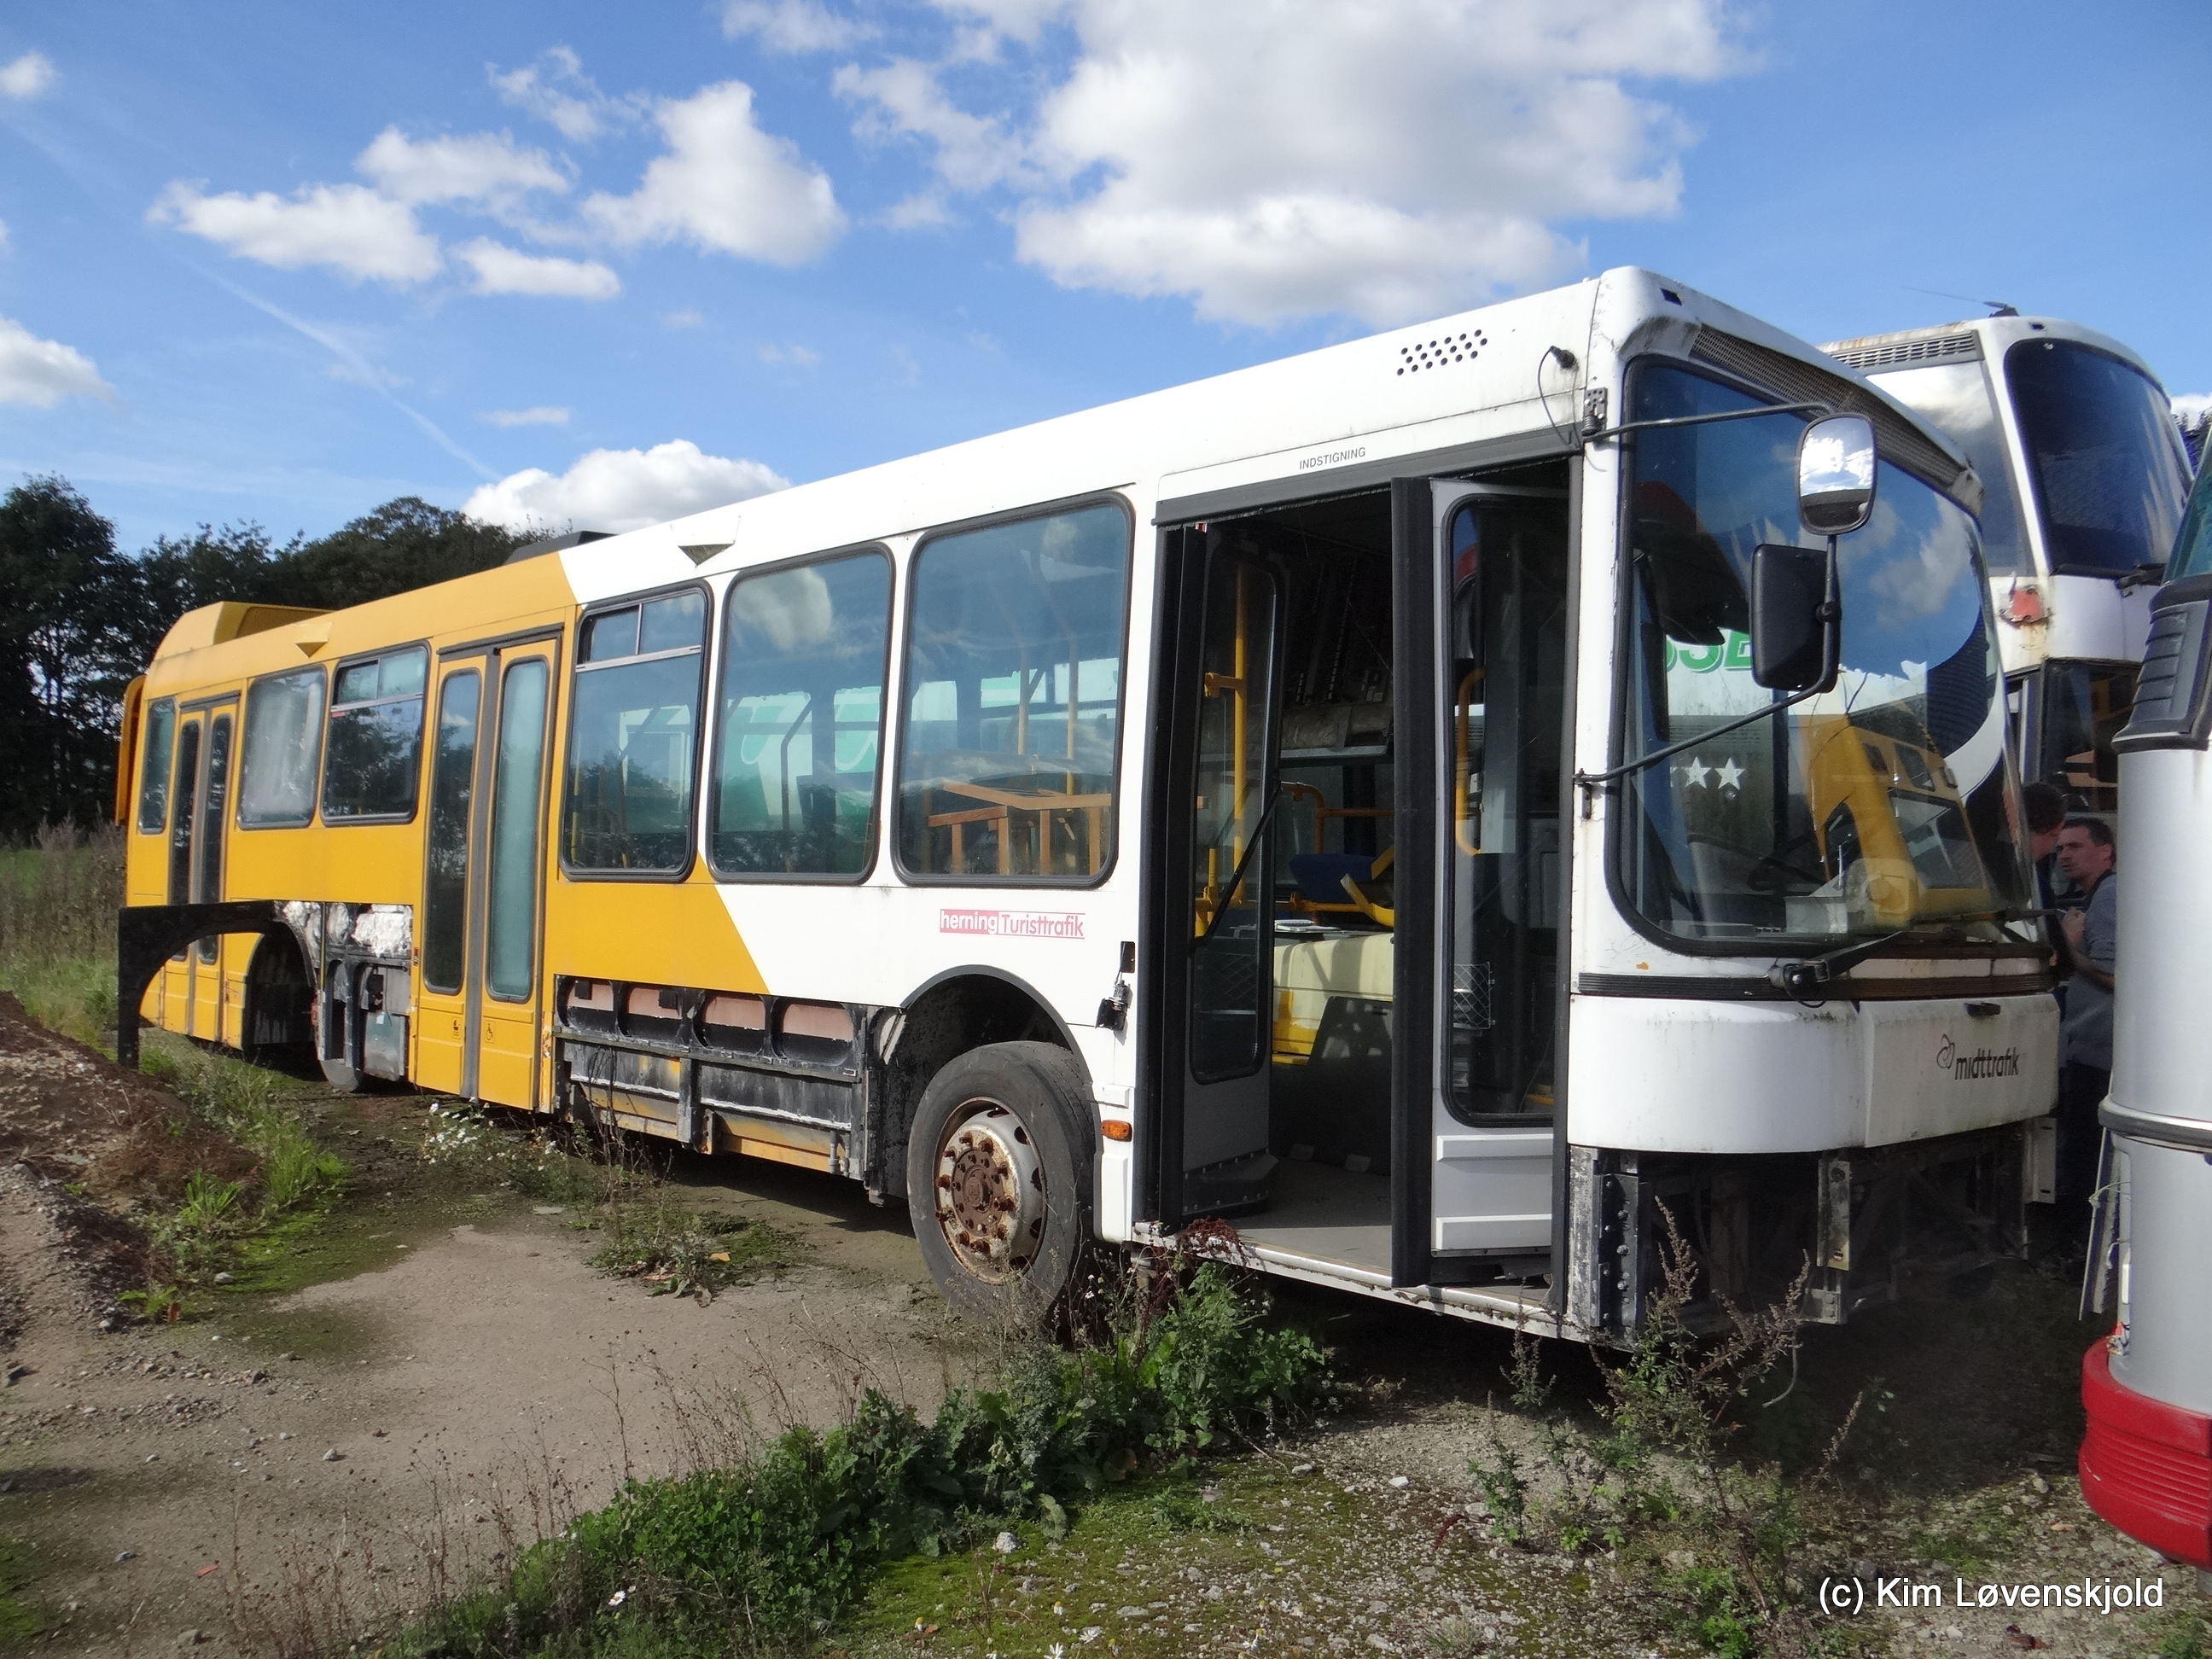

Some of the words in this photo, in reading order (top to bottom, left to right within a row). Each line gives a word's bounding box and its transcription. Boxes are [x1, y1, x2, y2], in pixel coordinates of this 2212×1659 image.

[1300, 447, 1365, 469] INDSTIGNING
[940, 910, 998, 934] herning
[1001, 914, 1084, 937] Turisttrafik
[1954, 1047, 2019, 1080] midttrafik
